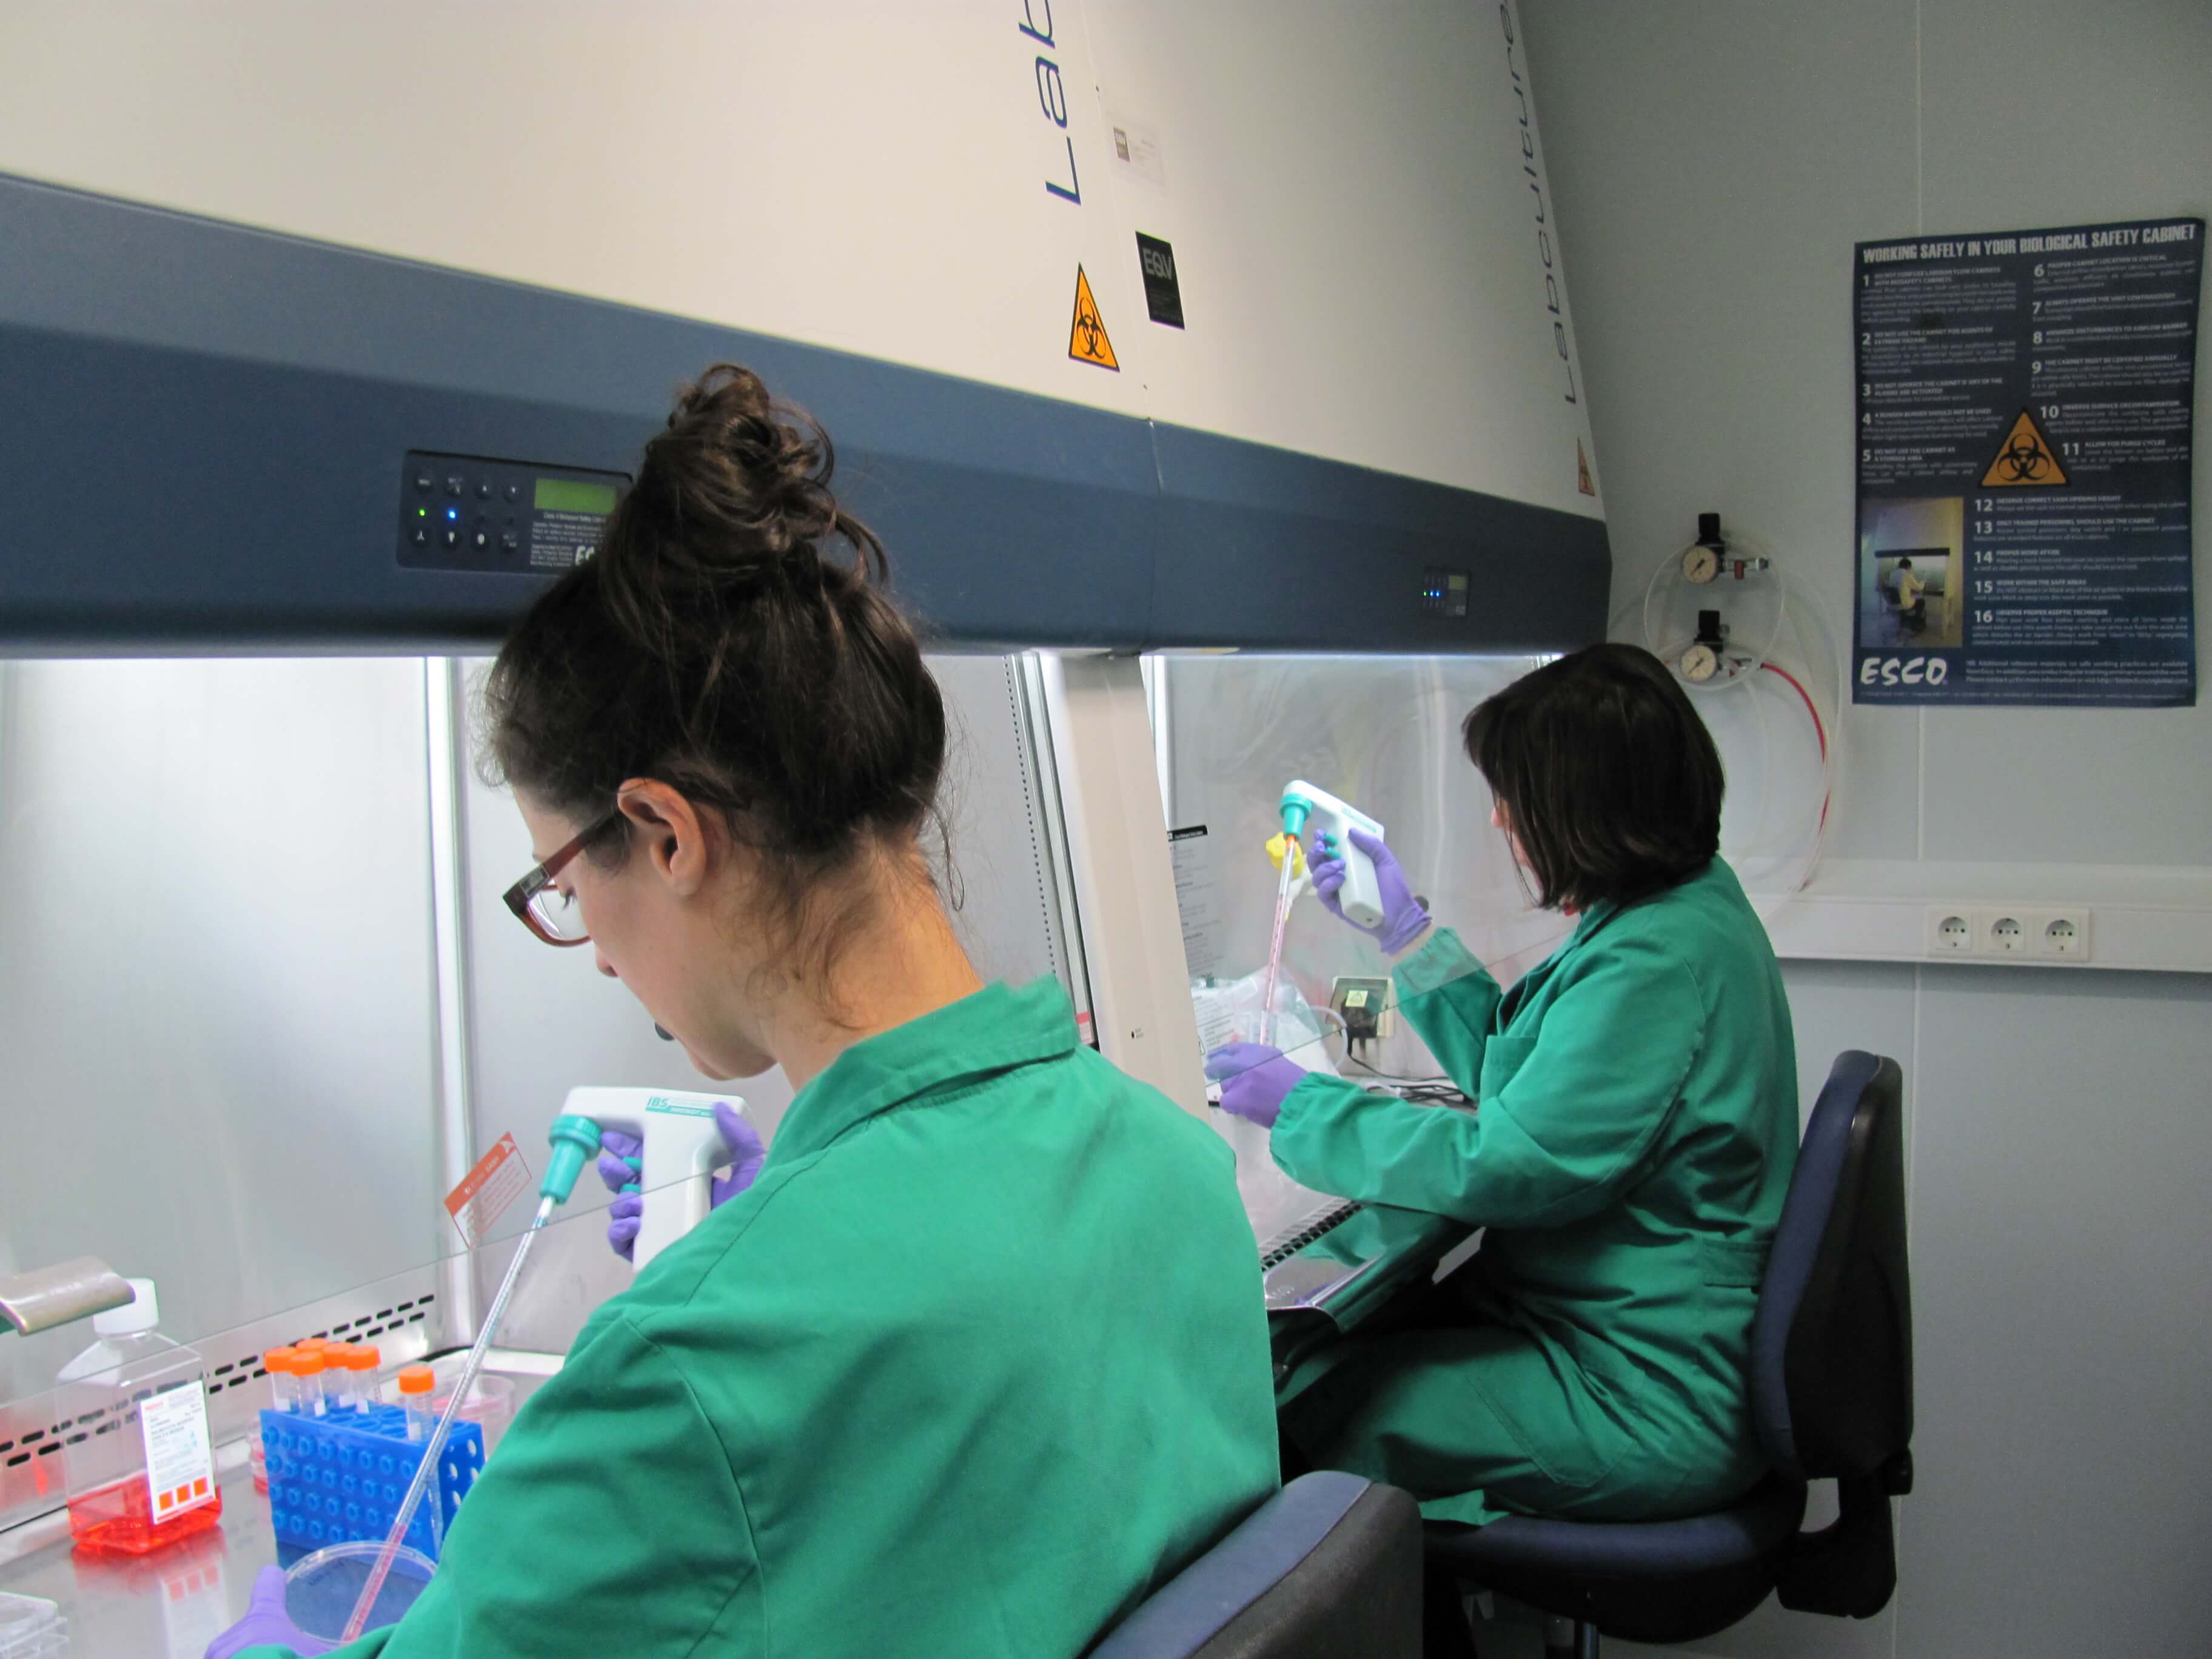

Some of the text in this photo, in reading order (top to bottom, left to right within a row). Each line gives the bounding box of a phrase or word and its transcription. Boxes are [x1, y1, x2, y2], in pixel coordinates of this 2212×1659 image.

[1863, 224, 2195, 264] WORKING SAFELY IN YOUR BIOLOGICAL SAFETY CABINET
[2034, 264, 2044, 277] 6
[1863, 275, 1869, 286] 1
[2033, 302, 2041, 314] 7
[1862, 333, 1871, 345] 2
[2033, 332, 2043, 344] 8
[2032, 361, 2042, 374] 9
[1863, 384, 1871, 396] 3
[2040, 406, 2059, 418] 10
[1863, 413, 1871, 425] 4
[1863, 449, 1871, 461] 5
[2063, 443, 2079, 455] 11
[1975, 499, 1992, 512] 12
[1975, 521, 1992, 534] 13
[1975, 551, 1992, 563] 14
[1975, 581, 1992, 593] 15
[1975, 611, 1992, 623] 16
[1860, 657, 1947, 686] ESCO
[647, 1096, 669, 1107] IBS
